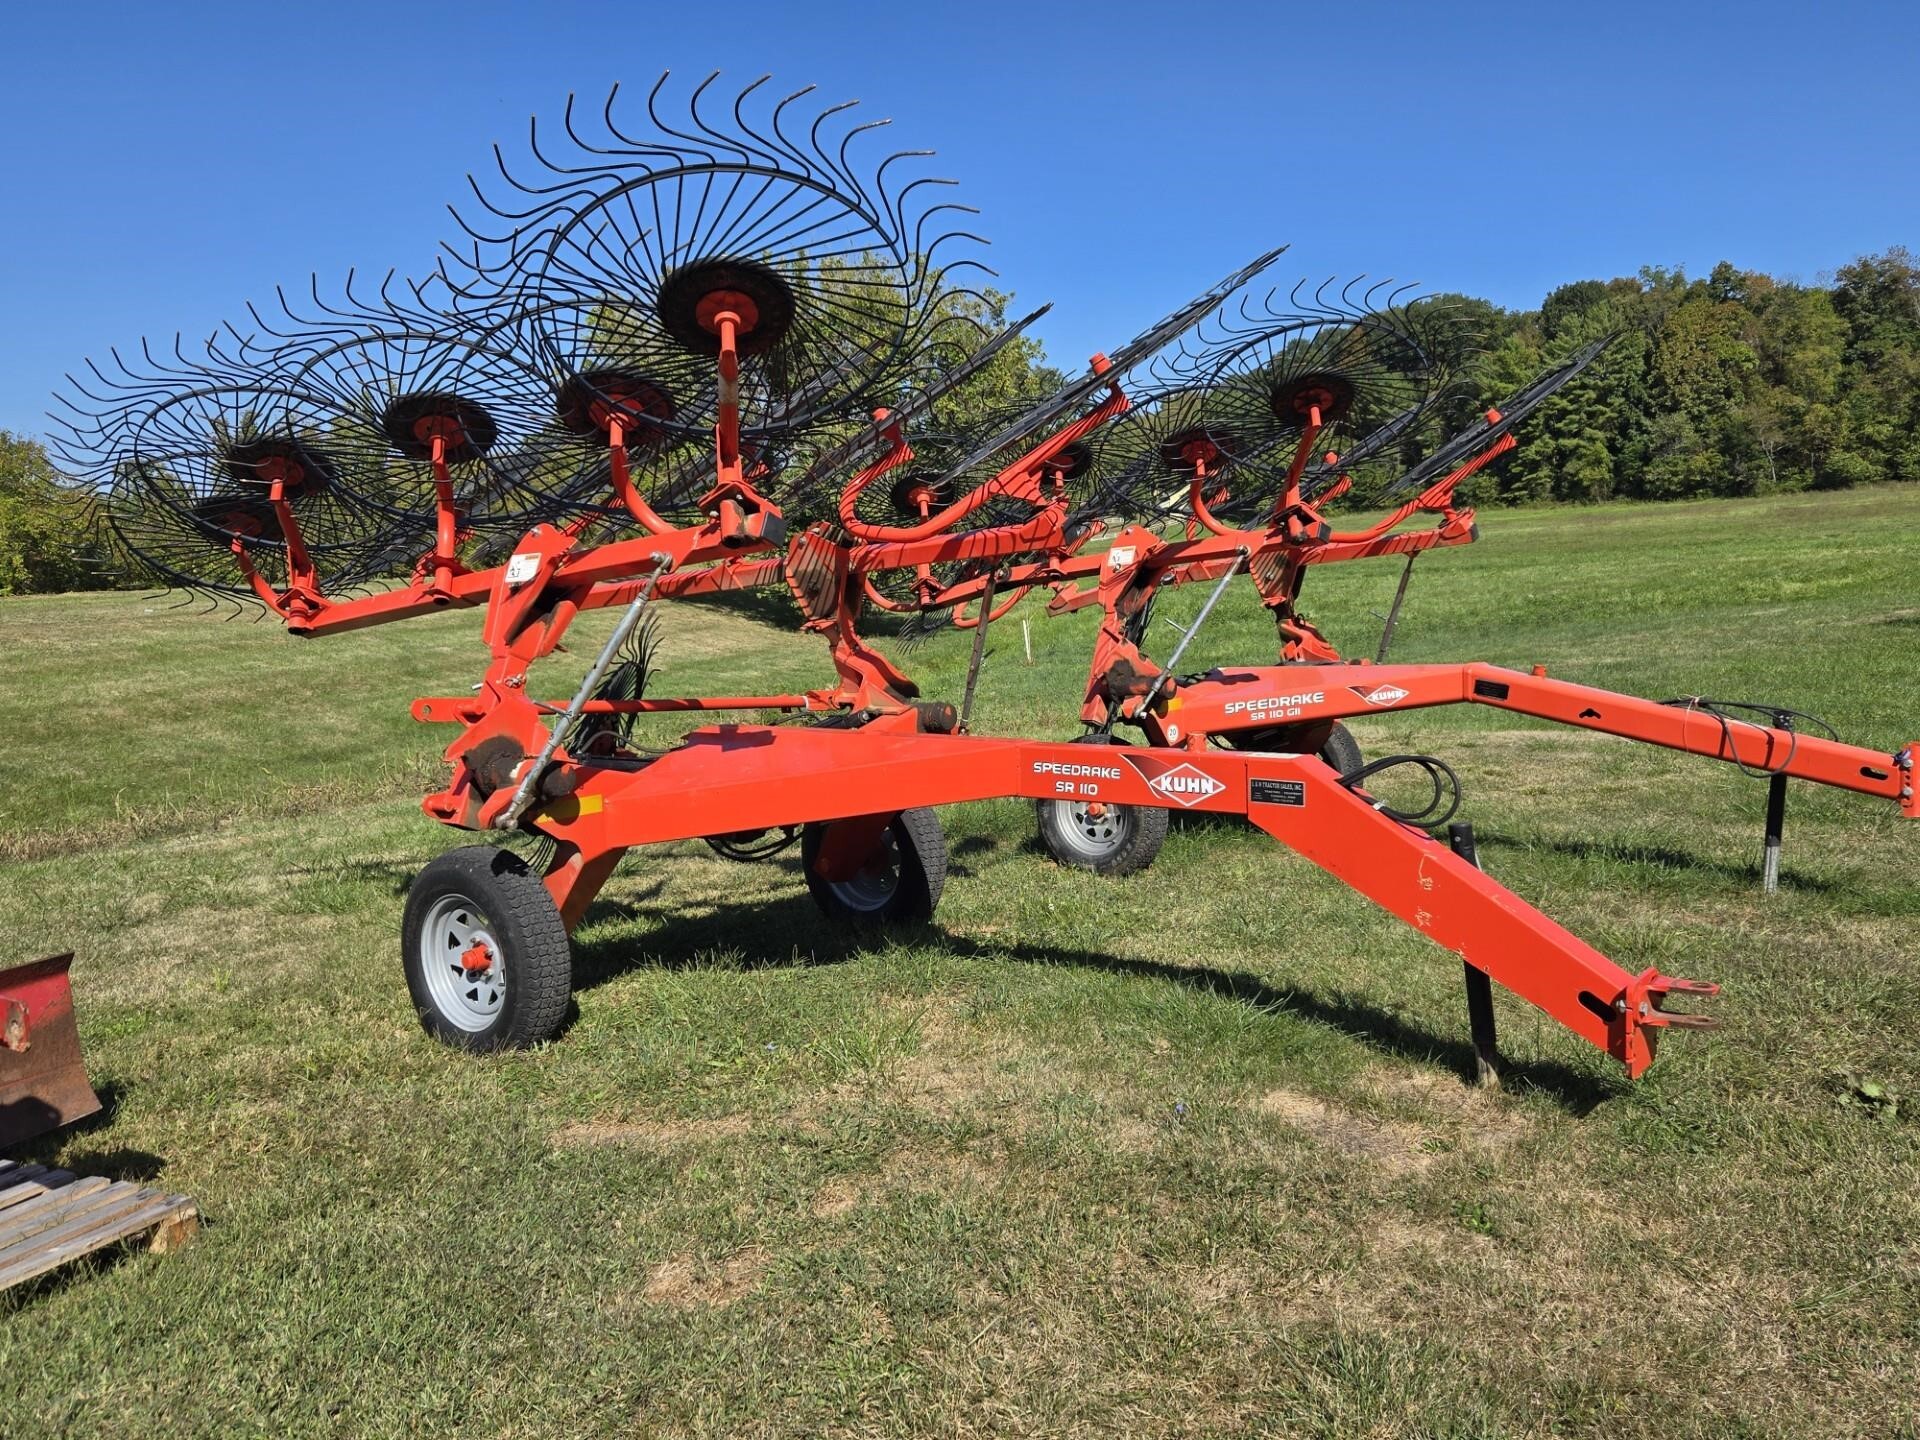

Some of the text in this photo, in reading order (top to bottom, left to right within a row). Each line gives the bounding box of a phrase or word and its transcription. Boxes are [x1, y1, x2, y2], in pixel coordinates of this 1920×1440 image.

[1224, 692, 1325, 713] SPEEDRAKE
[1250, 712, 1265, 720] SR
[1269, 709, 1284, 718] 110
[1033, 762, 1121, 779] SPEEDRAKE
[1055, 781, 1098, 795] SR 110
[1160, 776, 1214, 794] KUHN
